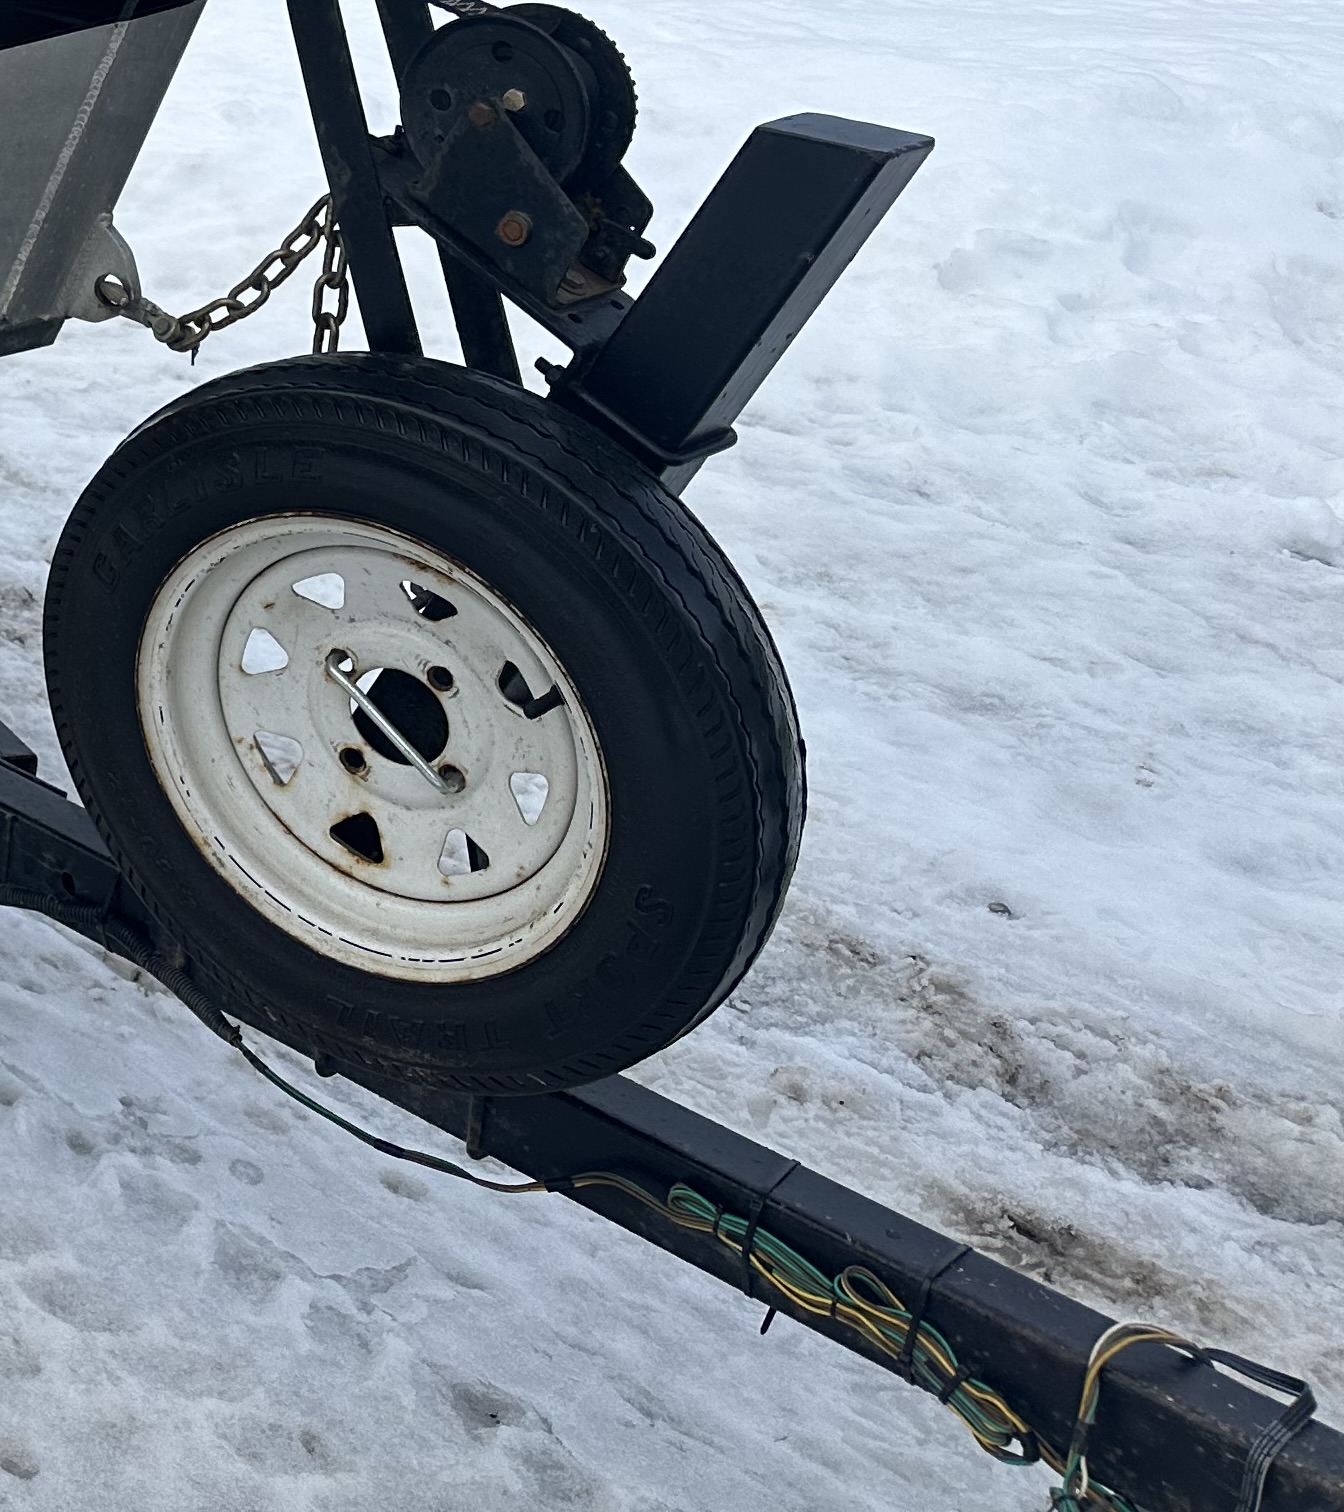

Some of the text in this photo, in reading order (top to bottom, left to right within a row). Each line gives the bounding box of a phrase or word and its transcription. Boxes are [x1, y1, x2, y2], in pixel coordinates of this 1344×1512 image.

[91, 445, 325, 595] CARLISLE
[324, 885, 673, 1054] SPORT TRAIL
